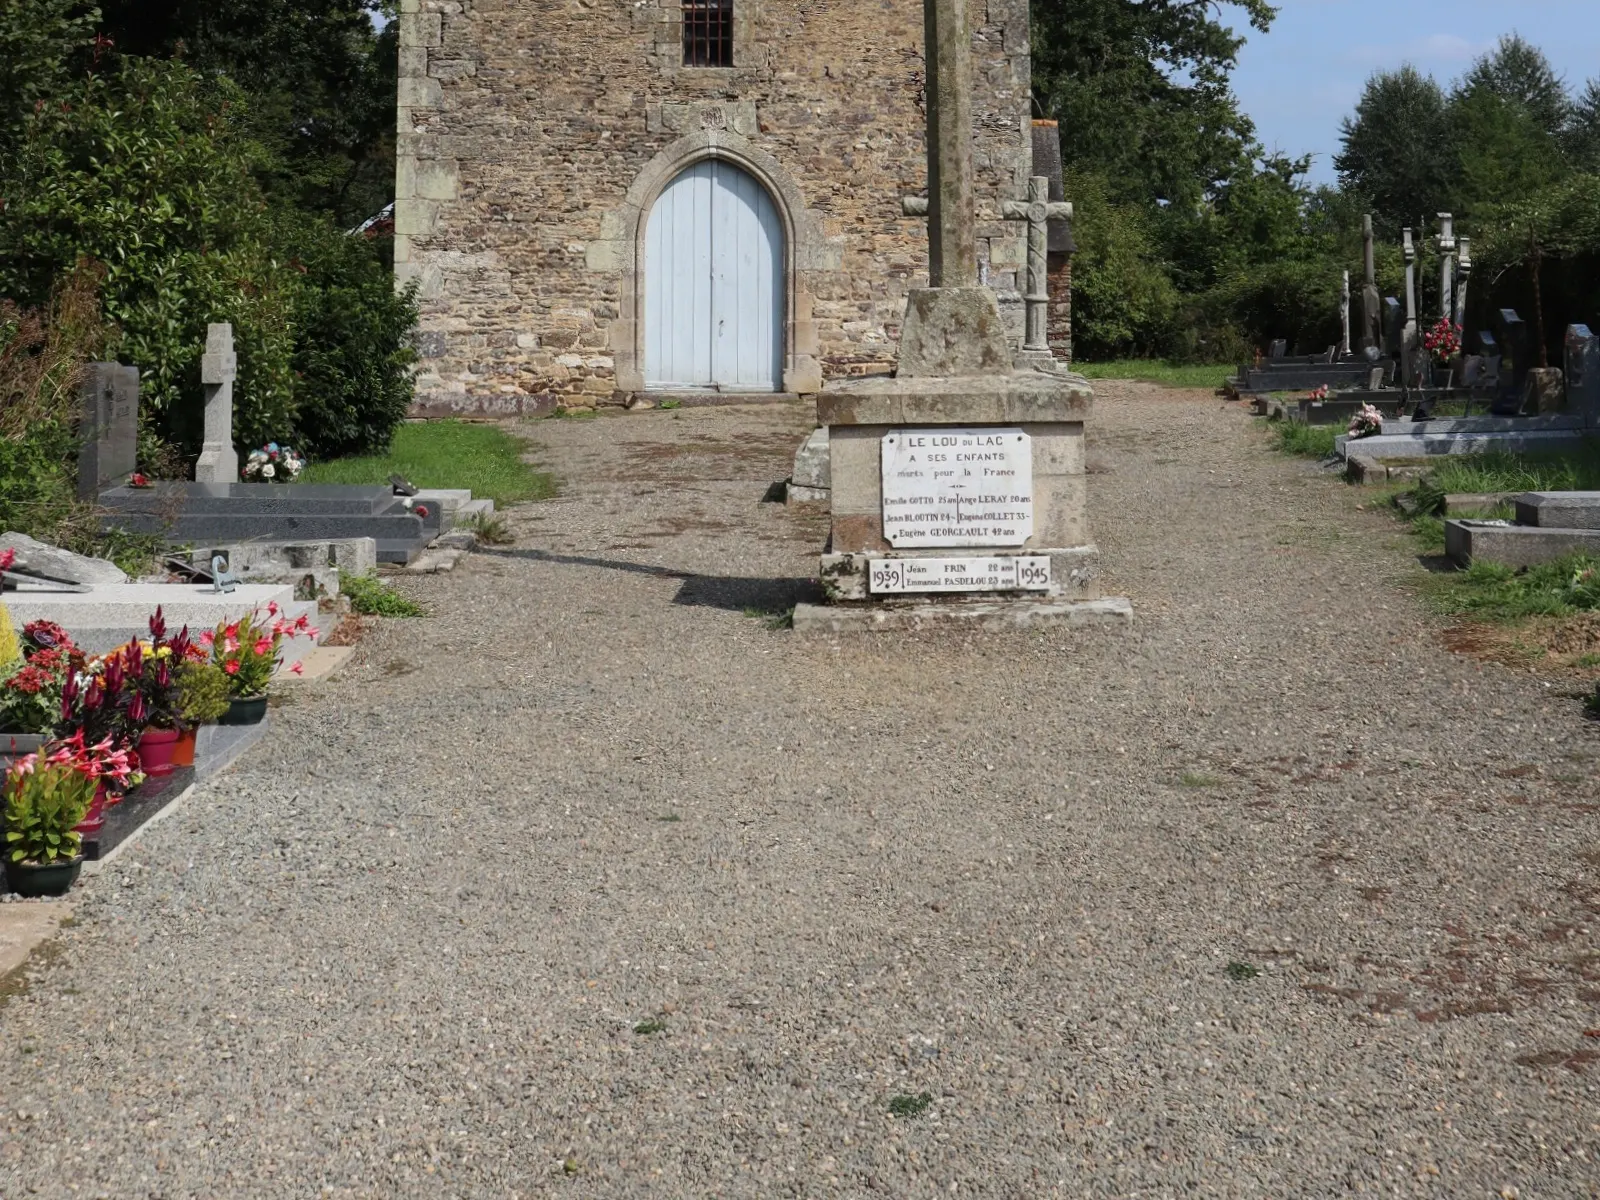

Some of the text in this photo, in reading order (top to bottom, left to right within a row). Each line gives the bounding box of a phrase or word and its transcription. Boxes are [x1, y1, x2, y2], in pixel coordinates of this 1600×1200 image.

[908, 437, 926, 448] LE
[932, 437, 958, 447] LOU
[977, 436, 1003, 446] LAC
[927, 454, 948, 462] SES
[956, 453, 1005, 462] ENFANTS
[934, 471, 954, 480] pour
[964, 468, 972, 477] la
[984, 468, 1015, 477] France
[959, 496, 977, 505] Ange
[978, 495, 1007, 503] LERAY
[1010, 495, 1019, 503] 20
[886, 513, 950, 523] Jean BLOUTIN 24
[984, 512, 1014, 520] COLLET
[1016, 512, 1025, 520] 33
[930, 527, 988, 536] GEORGEAULT
[906, 565, 927, 573] Jean
[944, 564, 966, 573] FRIN
[988, 563, 998, 572] 22
[873, 571, 900, 587] 1939
[906, 577, 942, 586] Emmanuel
[944, 577, 987, 586] PASDELOU
[988, 576, 998, 585] 23
[1021, 568, 1048, 585] 1945
